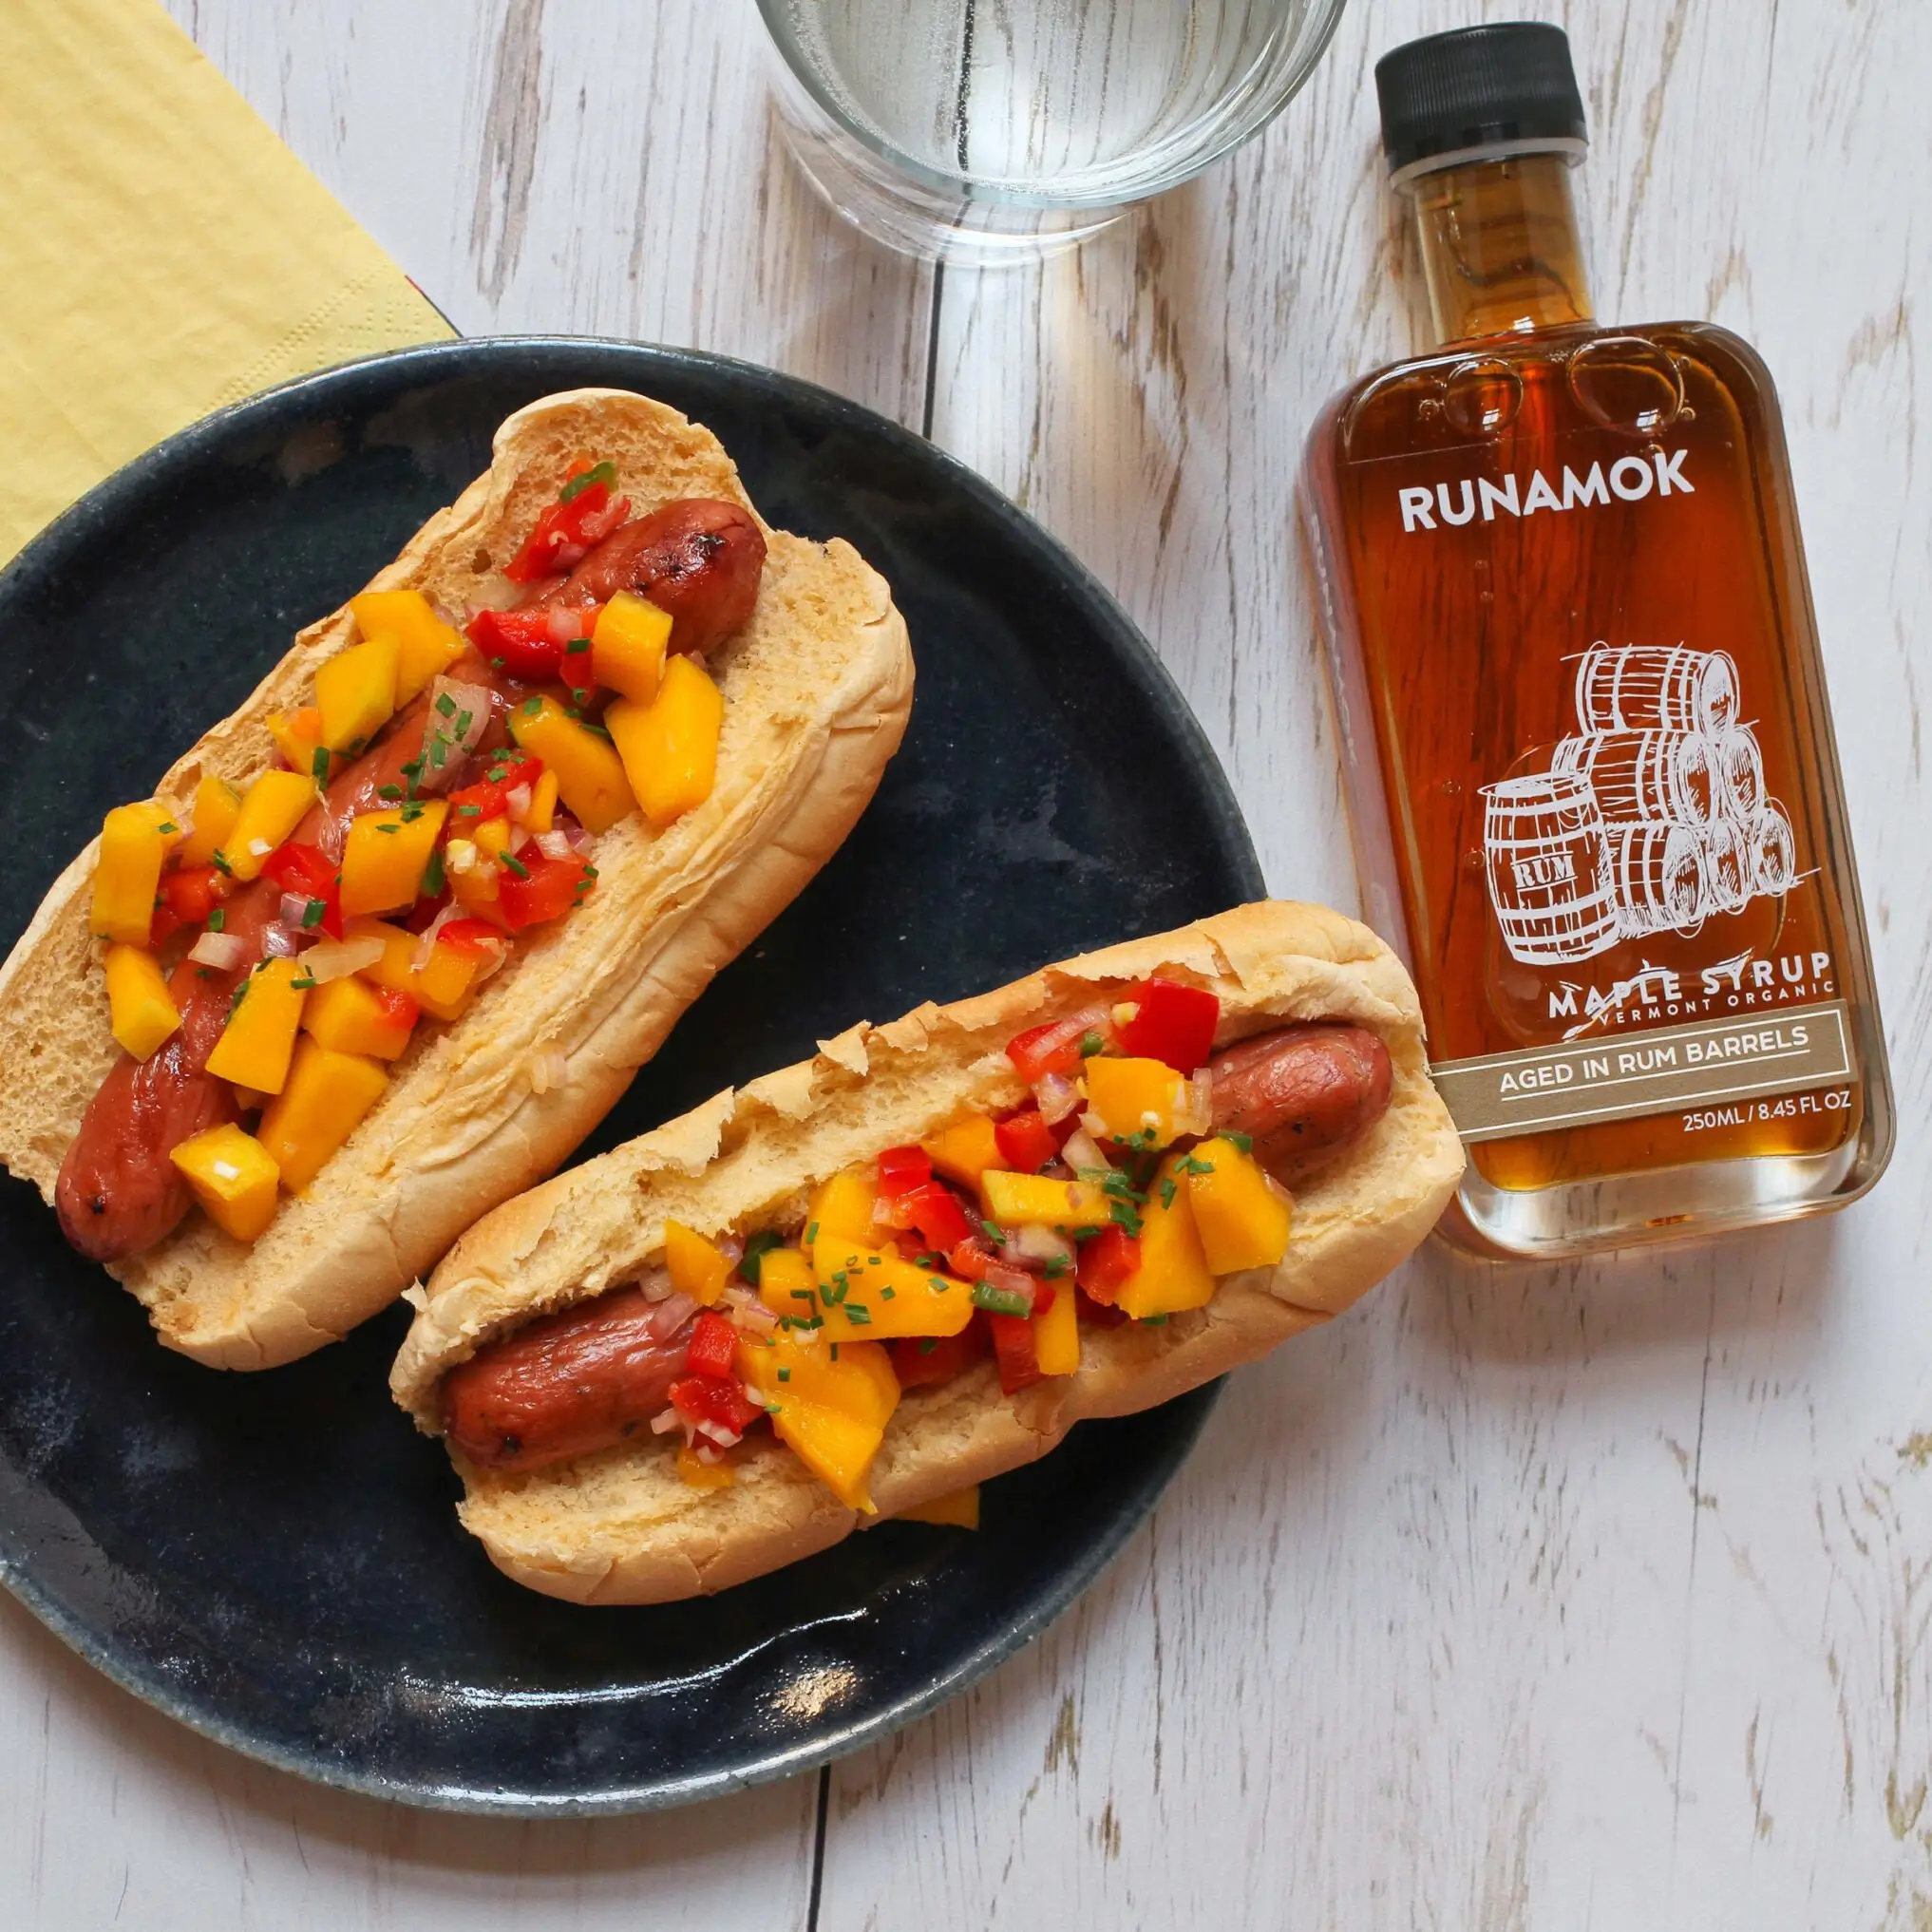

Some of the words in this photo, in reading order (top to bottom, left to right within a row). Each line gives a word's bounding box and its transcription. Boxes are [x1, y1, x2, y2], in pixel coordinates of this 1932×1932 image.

[1398, 449, 1695, 533] RUNAMOK
[1511, 855, 1577, 889] RUM
[1548, 972, 1682, 1018] MAPLE
[1701, 953, 1829, 995] SYRUP
[1600, 1000, 1711, 1026] VERMONT
[1727, 980, 1834, 1007] ORGANIC
[1500, 1064, 1573, 1092] AGED
[1583, 1057, 1609, 1079] IN
[1619, 1047, 1677, 1073] RUM
[1686, 1026, 1809, 1063] BARRELS
[1683, 1107, 1745, 1131] 250ML
[1748, 1105, 1753, 1123] /
[1758, 1099, 1796, 1121] 8.45
[1800, 1095, 1822, 1114] FL
[1824, 1090, 1851, 1108] OZ
